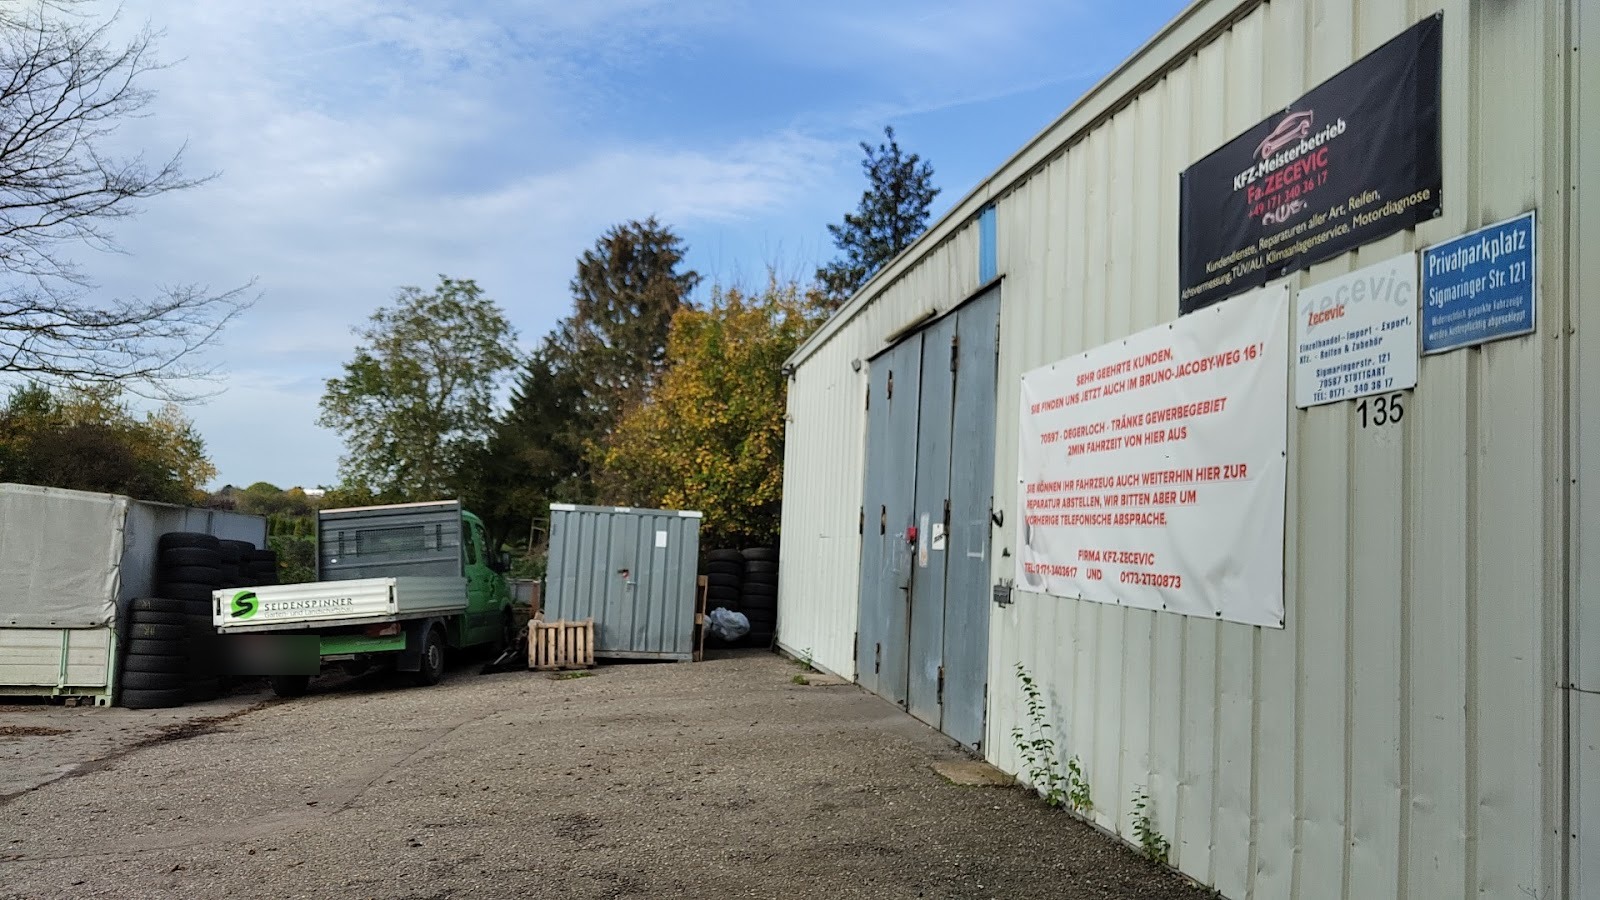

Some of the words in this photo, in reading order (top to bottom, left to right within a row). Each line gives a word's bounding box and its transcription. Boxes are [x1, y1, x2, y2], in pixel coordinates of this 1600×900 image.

[1233, 117, 1346, 191] KFZ-Meisterbetrieb
[1248, 203, 1264, 218] +49
[1268, 195, 1281, 209] 171
[1285, 184, 1300, 202] 340
[1303, 179, 1314, 194] 36
[1317, 170, 1327, 185] 17
[1353, 188, 1431, 229] Motordiagnose
[1259, 221, 1307, 250] Reparaturen
[1309, 212, 1327, 231] aller
[1348, 189, 1380, 211] Reifen,
[1429, 229, 1526, 277] Privatparkplatz
[1429, 278, 1486, 308] Sigmaringer
[1489, 268, 1506, 289] Str.
[1509, 261, 1526, 284] 121
[1381, 316, 1412, 332] Export,
[1320, 346, 1342, 360] Reifen
[1344, 344, 1349, 353] &
[1352, 337, 1383, 352] Zubehör
[1031, 402, 1040, 415] SIE
[1041, 396, 1064, 412] FINDEN
[1065, 392, 1080, 406] UNS
[1081, 387, 1102, 402] JETZT
[1103, 380, 1126, 396] AUCH
[1127, 377, 1137, 390] IM
[1139, 349, 1241, 387] BRUNO-JACOBY-WEG
[1243, 344, 1257, 361] 16
[1076, 371, 1095, 386] SEHR
[1096, 359, 1131, 380] GEEHRTE
[1132, 348, 1173, 370] KUNDEN,
[1316, 358, 1375, 378] Sigmaringerstr.
[1379, 352, 1391, 364] 121
[1344, 367, 1386, 383] STUTTGART
[1313, 391, 1327, 402] TEL:
[1329, 388, 1345, 399] 0171
[1354, 384, 1369, 394] 340
[1385, 377, 1393, 387] 17
[1041, 430, 1059, 444] 70597
[1063, 422, 1105, 440] DEGERLOCH
[1111, 413, 1143, 431] TRÄNKE
[1145, 397, 1228, 425] GEWERBEGEBIET
[1356, 393, 1404, 429] 135
[1067, 442, 1085, 456] 2MIN
[1087, 437, 1122, 454] FAHRZEIT
[1124, 433, 1143, 448] VON
[1144, 429, 1165, 445] HIER
[1167, 426, 1187, 441] AUS
[1027, 484, 1035, 494] SIE
[1036, 480, 1061, 493] KÖNNEN
[1062, 480, 1074, 491] IHR
[1075, 476, 1114, 490] FAHRZEUG
[1116, 473, 1140, 487] AUCH
[1142, 468, 1193, 485] WEITERHIN
[1195, 466, 1220, 481] HIER
[1223, 463, 1247, 479] ZUR
[1027, 498, 1060, 510] REPARATUR
[1062, 496, 1102, 509] ABSTELLEN,
[1103, 494, 1119, 507] WIR
[1121, 492, 1150, 506] BITTEN
[1152, 490, 1177, 504] ABER
[1179, 489, 1197, 503] UM
[1025, 514, 1059, 526] VORHERIGE
[1060, 513, 1112, 526] TELEFONISCHE
[1078, 549, 1100, 562] FIRMA
[1102, 550, 1155, 566] KFZ-ZECEVIC
[1086, 568, 1102, 581] UND
[1120, 571, 1181, 589] 0173-2730873
[264, 597, 354, 612] SEIDENSPINNER
